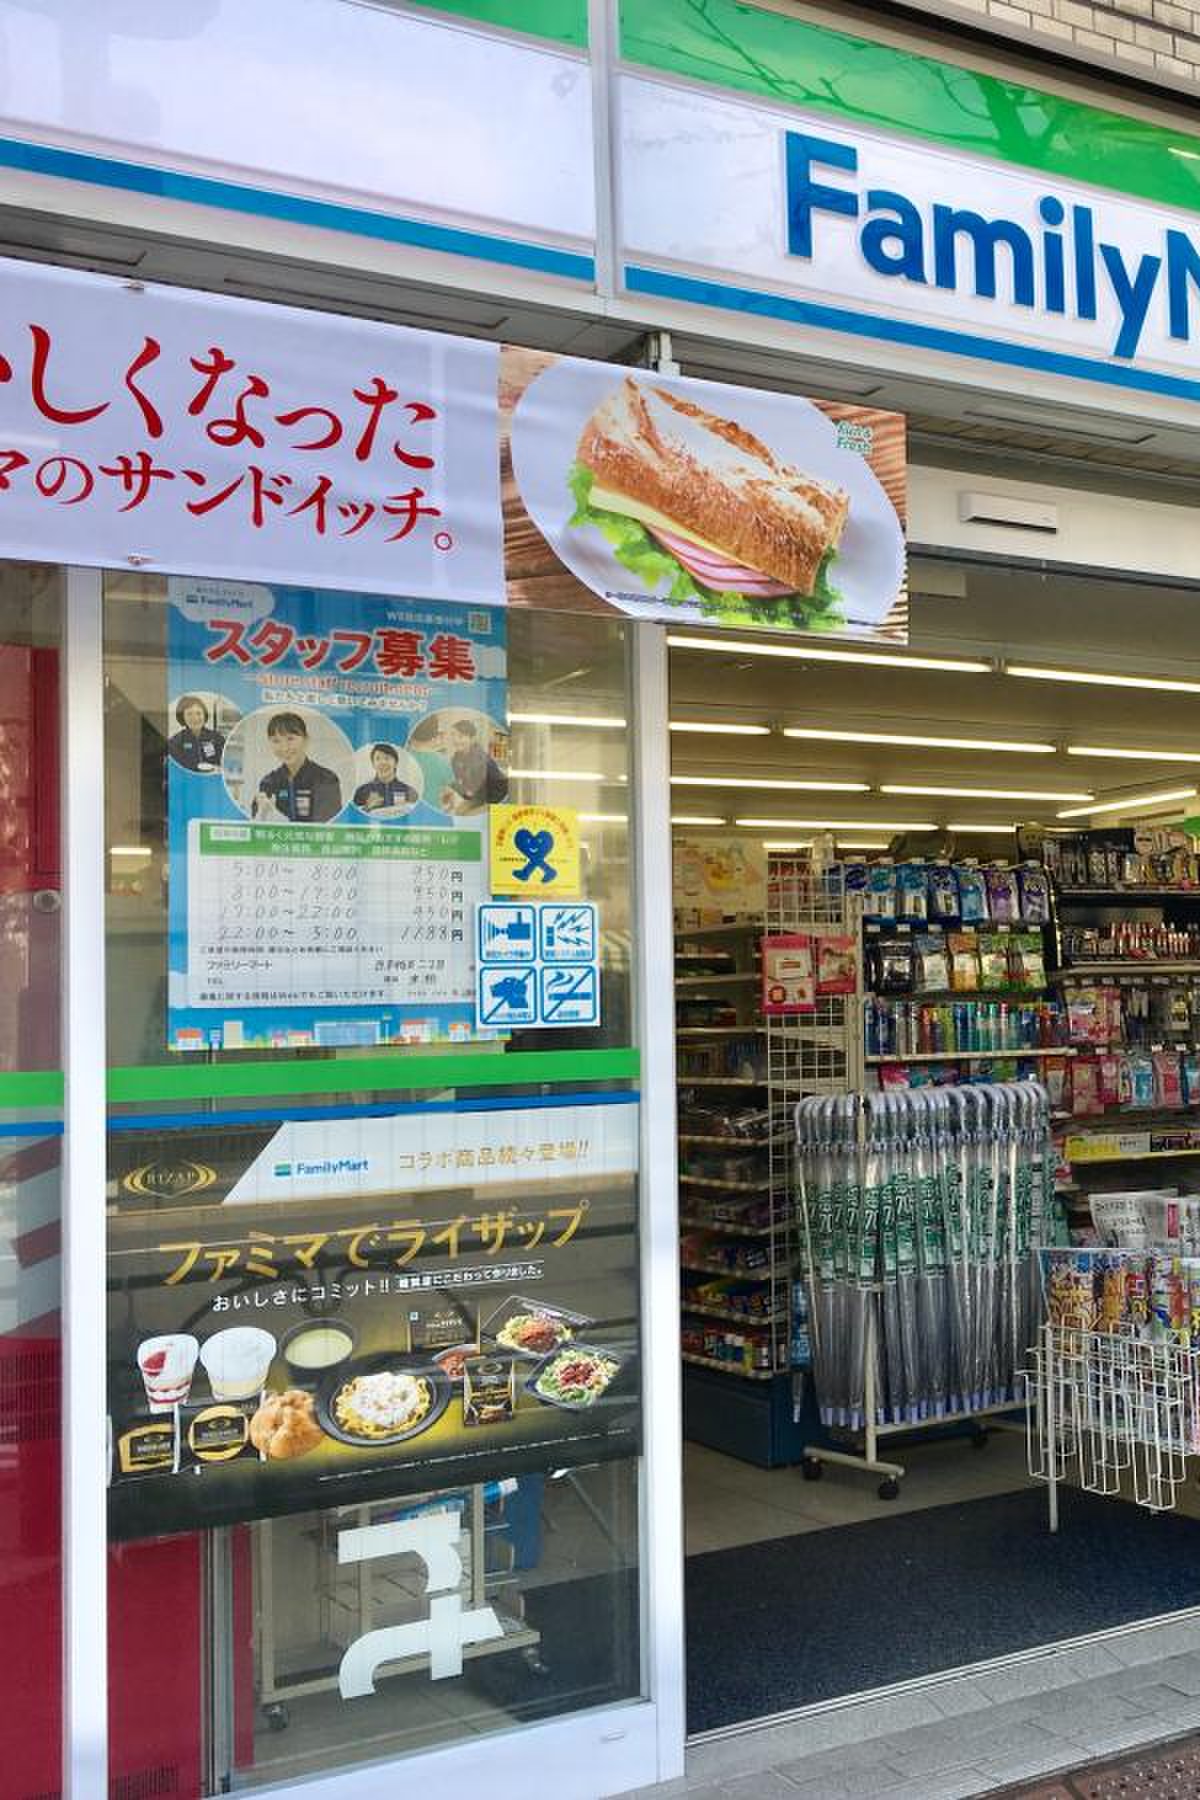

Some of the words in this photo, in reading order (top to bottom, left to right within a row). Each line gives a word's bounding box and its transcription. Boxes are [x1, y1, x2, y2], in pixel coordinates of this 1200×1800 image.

[0, 325, 437, 469] しくなった
[207, 619, 476, 683] スタッフ募集
[146, 1171, 196, 1186] RIZAP
[298, 1158, 369, 1176] FamilyMart
[158, 1199, 591, 1286] ファミマでライザップ
[211, 1279, 390, 1312] おいしさにコミット!!
